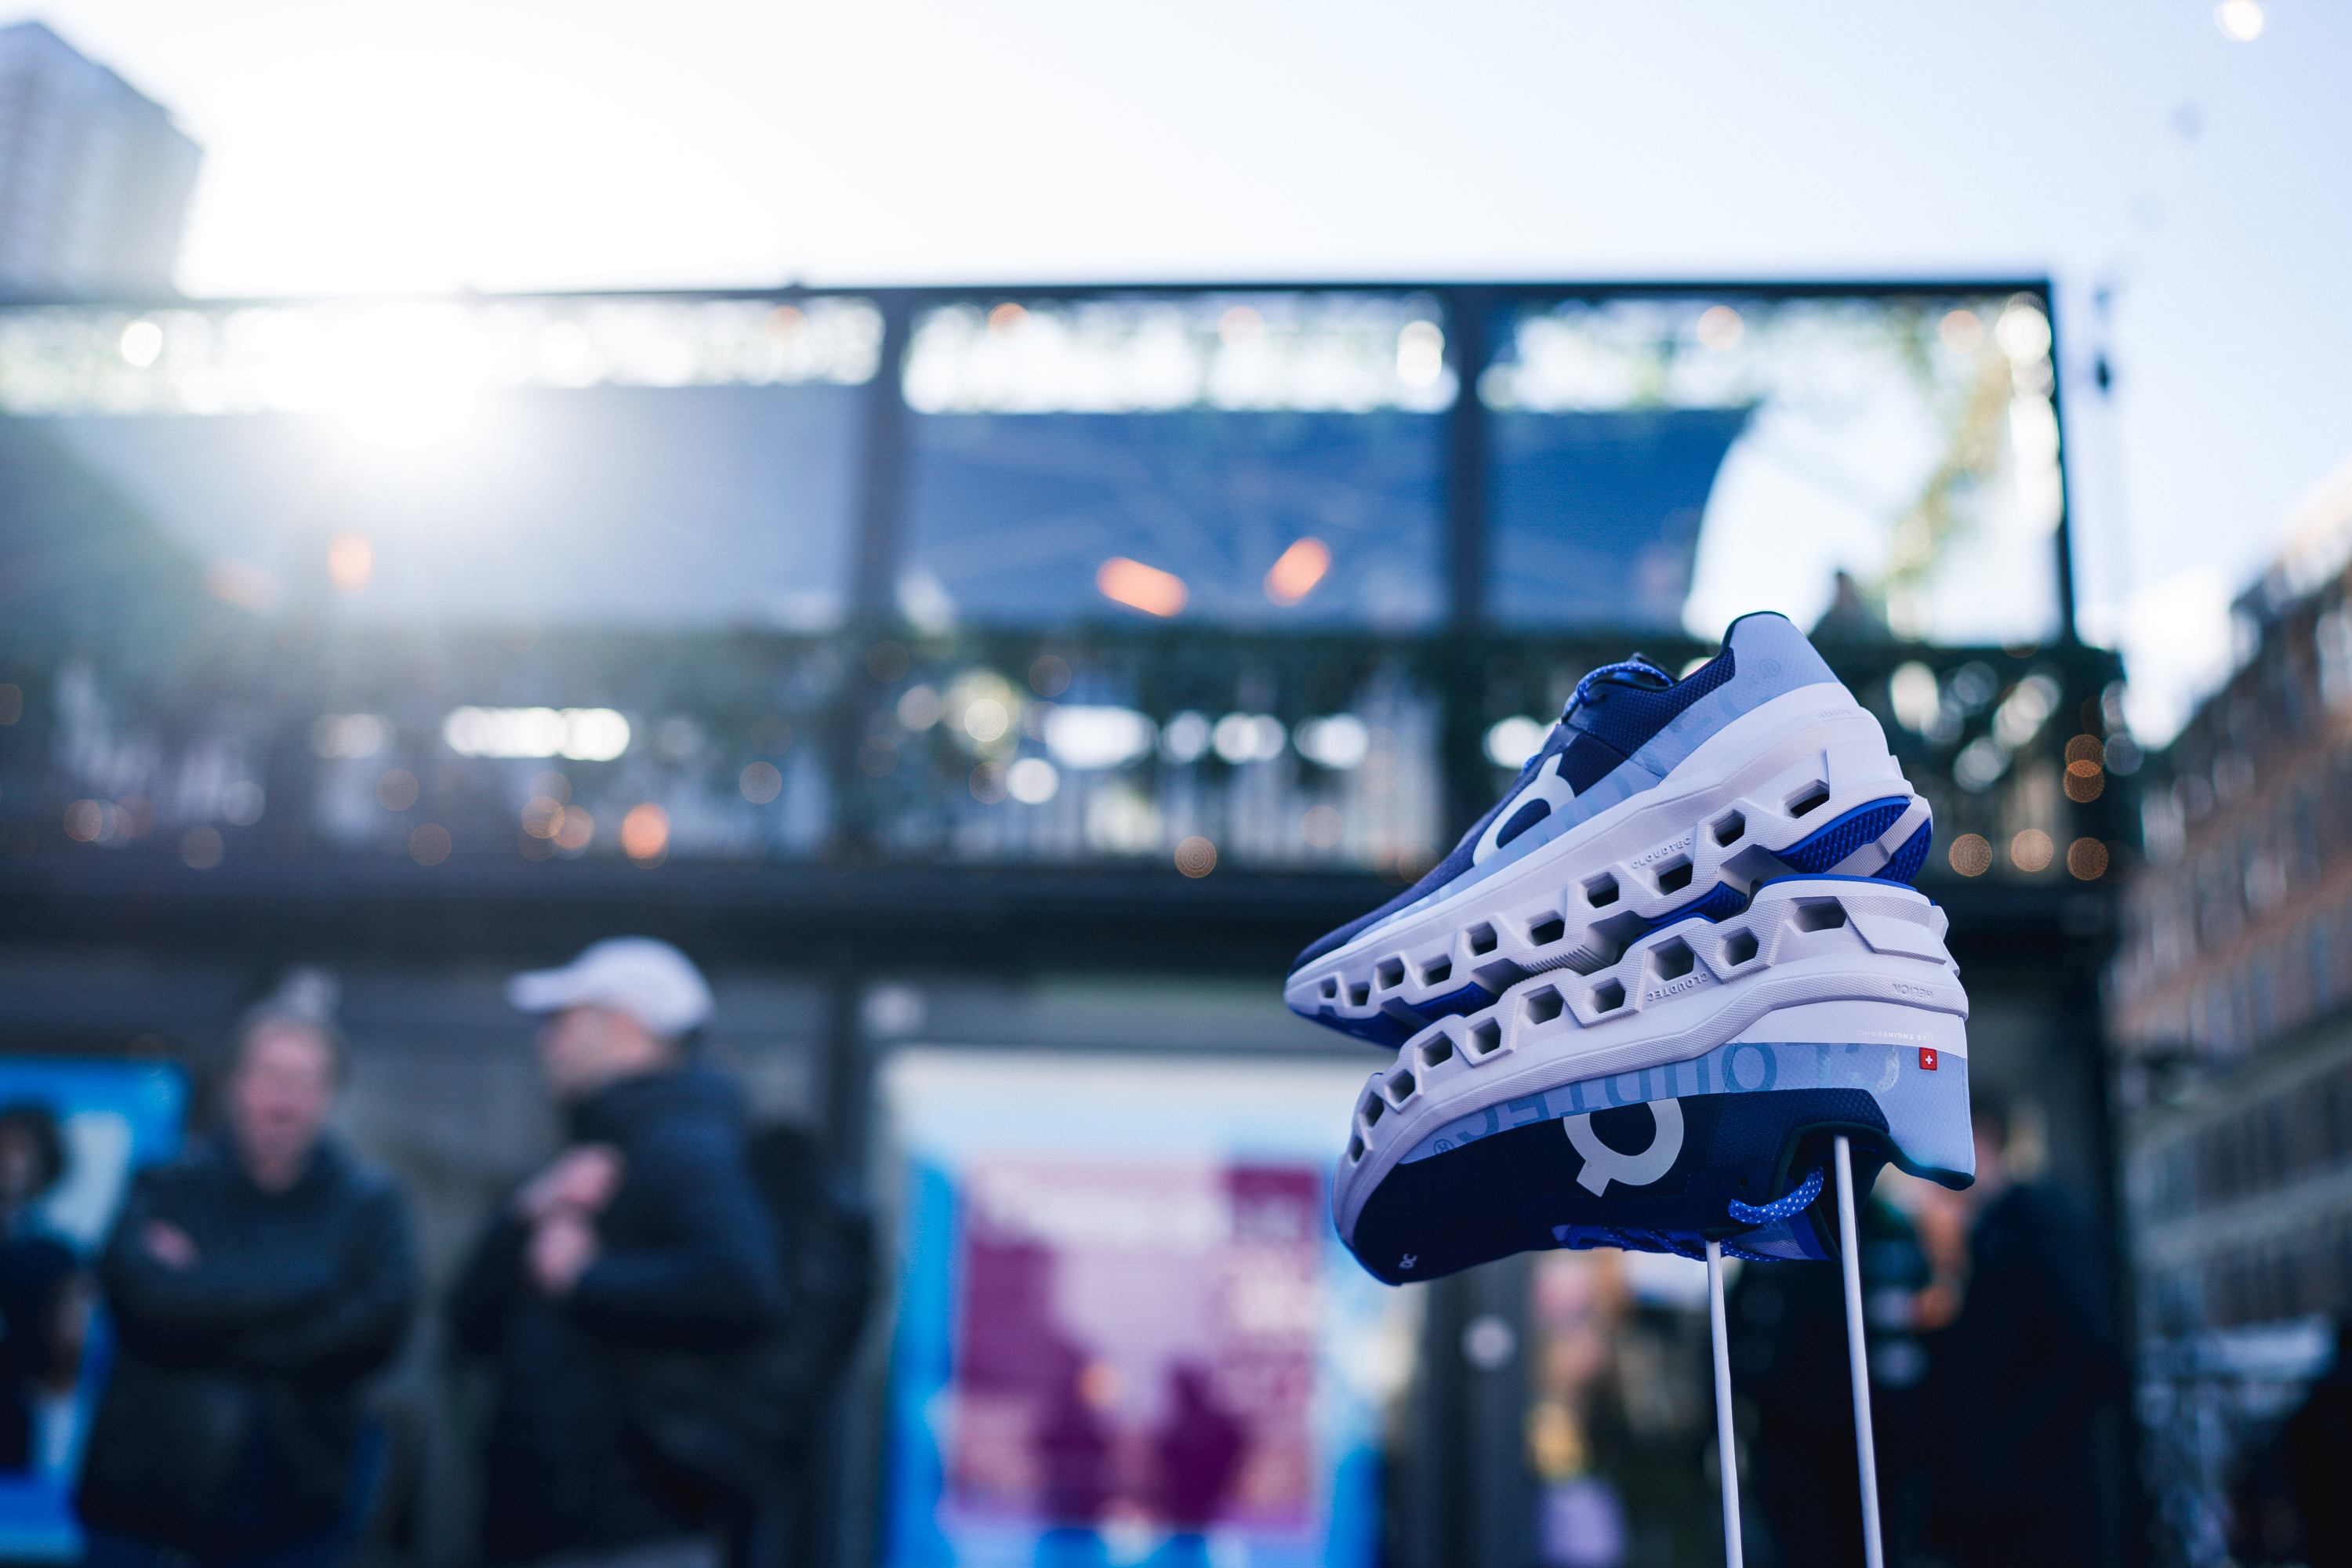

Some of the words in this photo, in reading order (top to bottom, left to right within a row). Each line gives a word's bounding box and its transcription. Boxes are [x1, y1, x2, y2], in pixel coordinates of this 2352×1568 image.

[1631, 837, 1691, 869] CLOUDTEC
[1646, 971, 1708, 1002] CLOUDTEC
[1892, 984, 1933, 999] HELION
[1855, 1030, 1914, 1040] ENGINEERING
